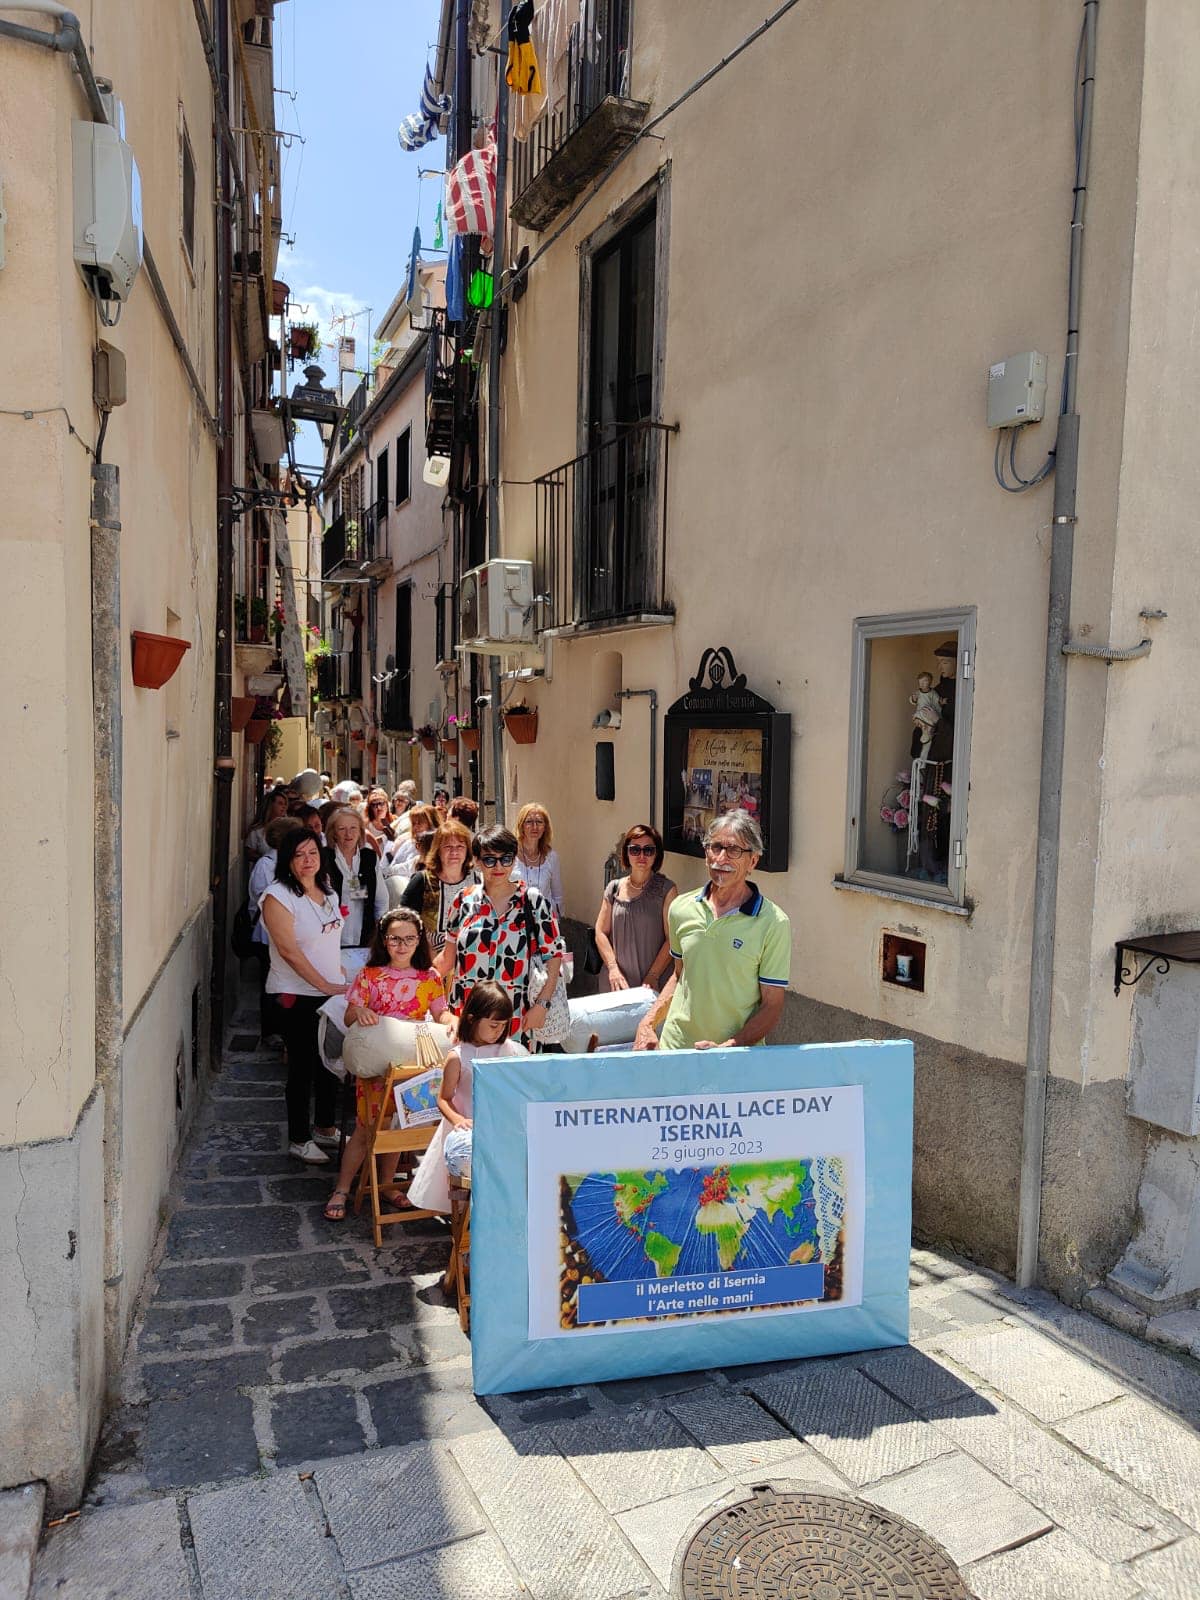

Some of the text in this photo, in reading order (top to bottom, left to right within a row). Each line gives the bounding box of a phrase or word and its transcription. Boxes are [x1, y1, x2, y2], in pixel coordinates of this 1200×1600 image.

[726, 693, 755, 709] Isernia
[554, 1095, 833, 1127] INTERNATIONAL LACE DAY
[660, 1122, 743, 1142] ISERNIA
[651, 1140, 764, 1163] 25 giugno 2023
[636, 1273, 766, 1296] il Merletto di Isernia
[648, 1292, 754, 1312] l'Arte nelle mani
[848, 1537, 873, 1554] 124
[874, 1553, 897, 1570] EN
